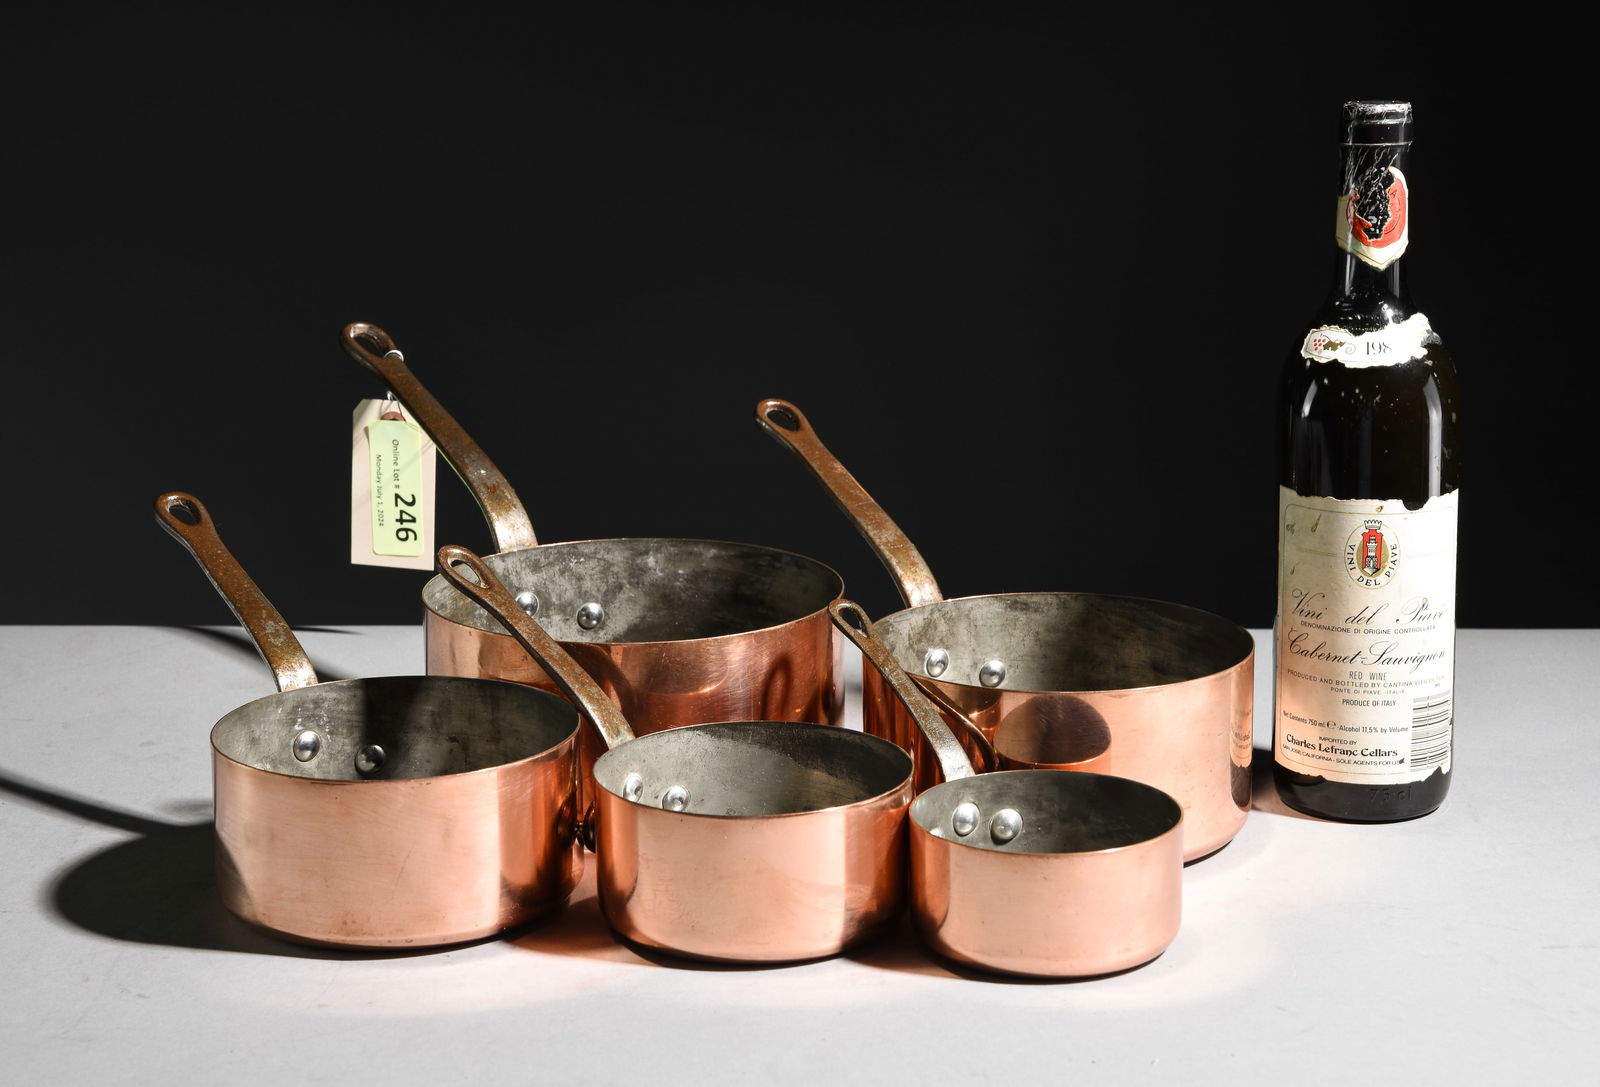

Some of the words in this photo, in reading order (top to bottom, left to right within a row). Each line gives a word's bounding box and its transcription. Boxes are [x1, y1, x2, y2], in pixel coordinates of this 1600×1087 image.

[392, 439, 400, 466] Online
[394, 493, 417, 542] 246
[1347, 544, 1356, 571] VINI
[1356, 575, 1381, 586] DEL
[1385, 543, 1398, 578] PIAVE
[1291, 588, 1327, 620] Vini
[1344, 603, 1389, 625] del
[1300, 621, 1351, 634] DENOMINAZIONE
[1394, 625, 1436, 635] CONTROLLATA
[1287, 668, 1318, 682] PRODUCED
[1335, 680, 1369, 688] BOTTLED
[1349, 671, 1363, 680] RED
[1369, 672, 1387, 681] WINE
[1342, 699, 1370, 707] PRODUCE
[1372, 699, 1380, 707] OF
[1381, 699, 1397, 707] ITALY
[1289, 712, 1308, 724] Contents
[1308, 718, 1318, 727] 750
[1286, 733, 1316, 751] Charles
[1318, 743, 1358, 757] Lefranc
[1361, 747, 1398, 757] Cellars
[1318, 736, 1349, 745] IMPORTED
[1302, 751, 1332, 762] CALIFORNIA
